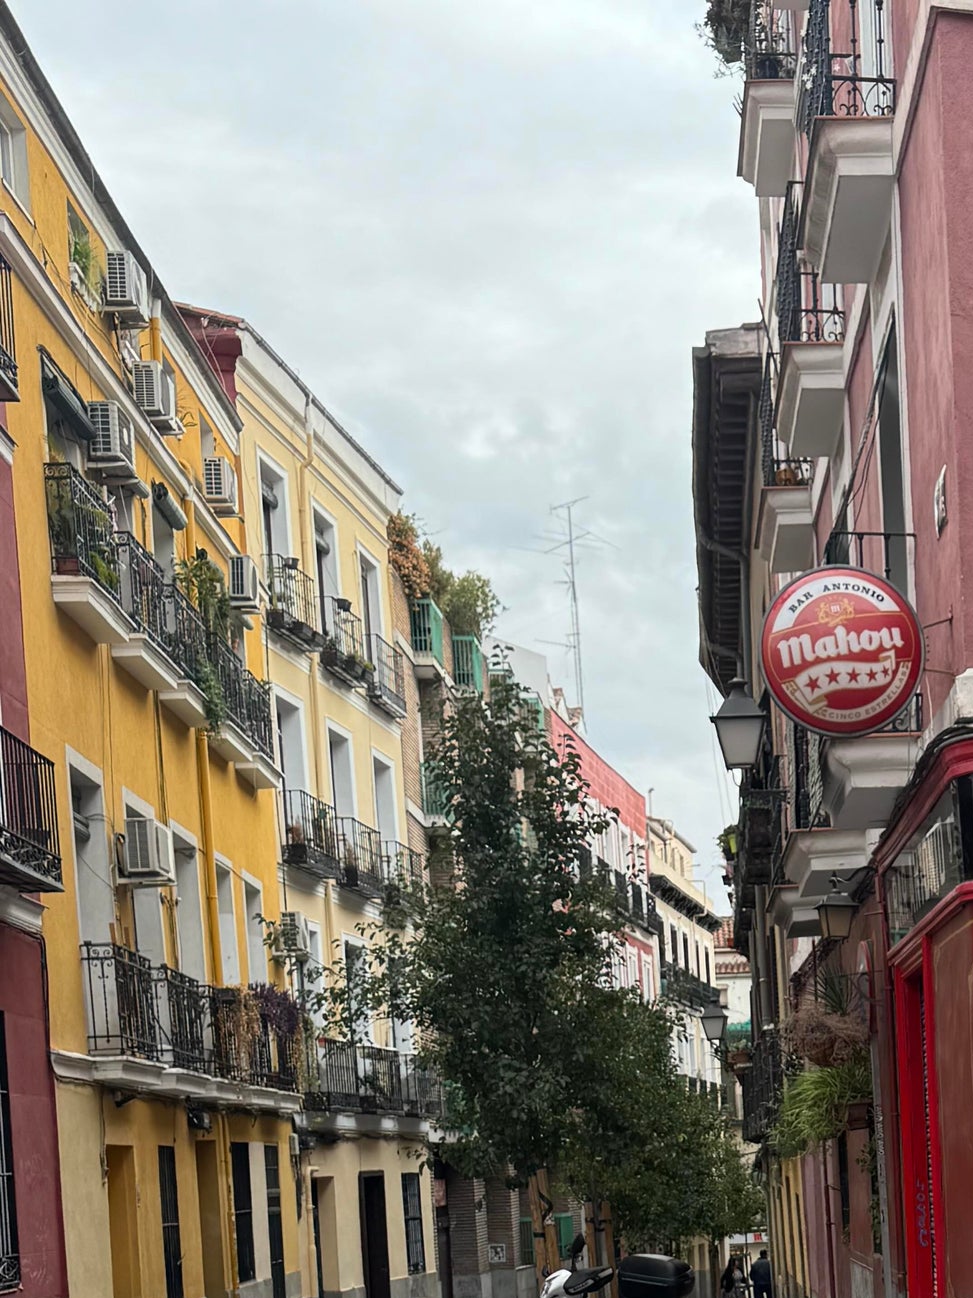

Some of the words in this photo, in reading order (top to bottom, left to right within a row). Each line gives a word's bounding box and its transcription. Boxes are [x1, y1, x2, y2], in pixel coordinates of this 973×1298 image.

[788, 591, 814, 613] BAR
[822, 583, 885, 603] ANTONIO
[777, 625, 904, 668] Mahou
[828, 711, 862, 720] CINCO
[865, 669, 908, 716] ESTRELLAS
